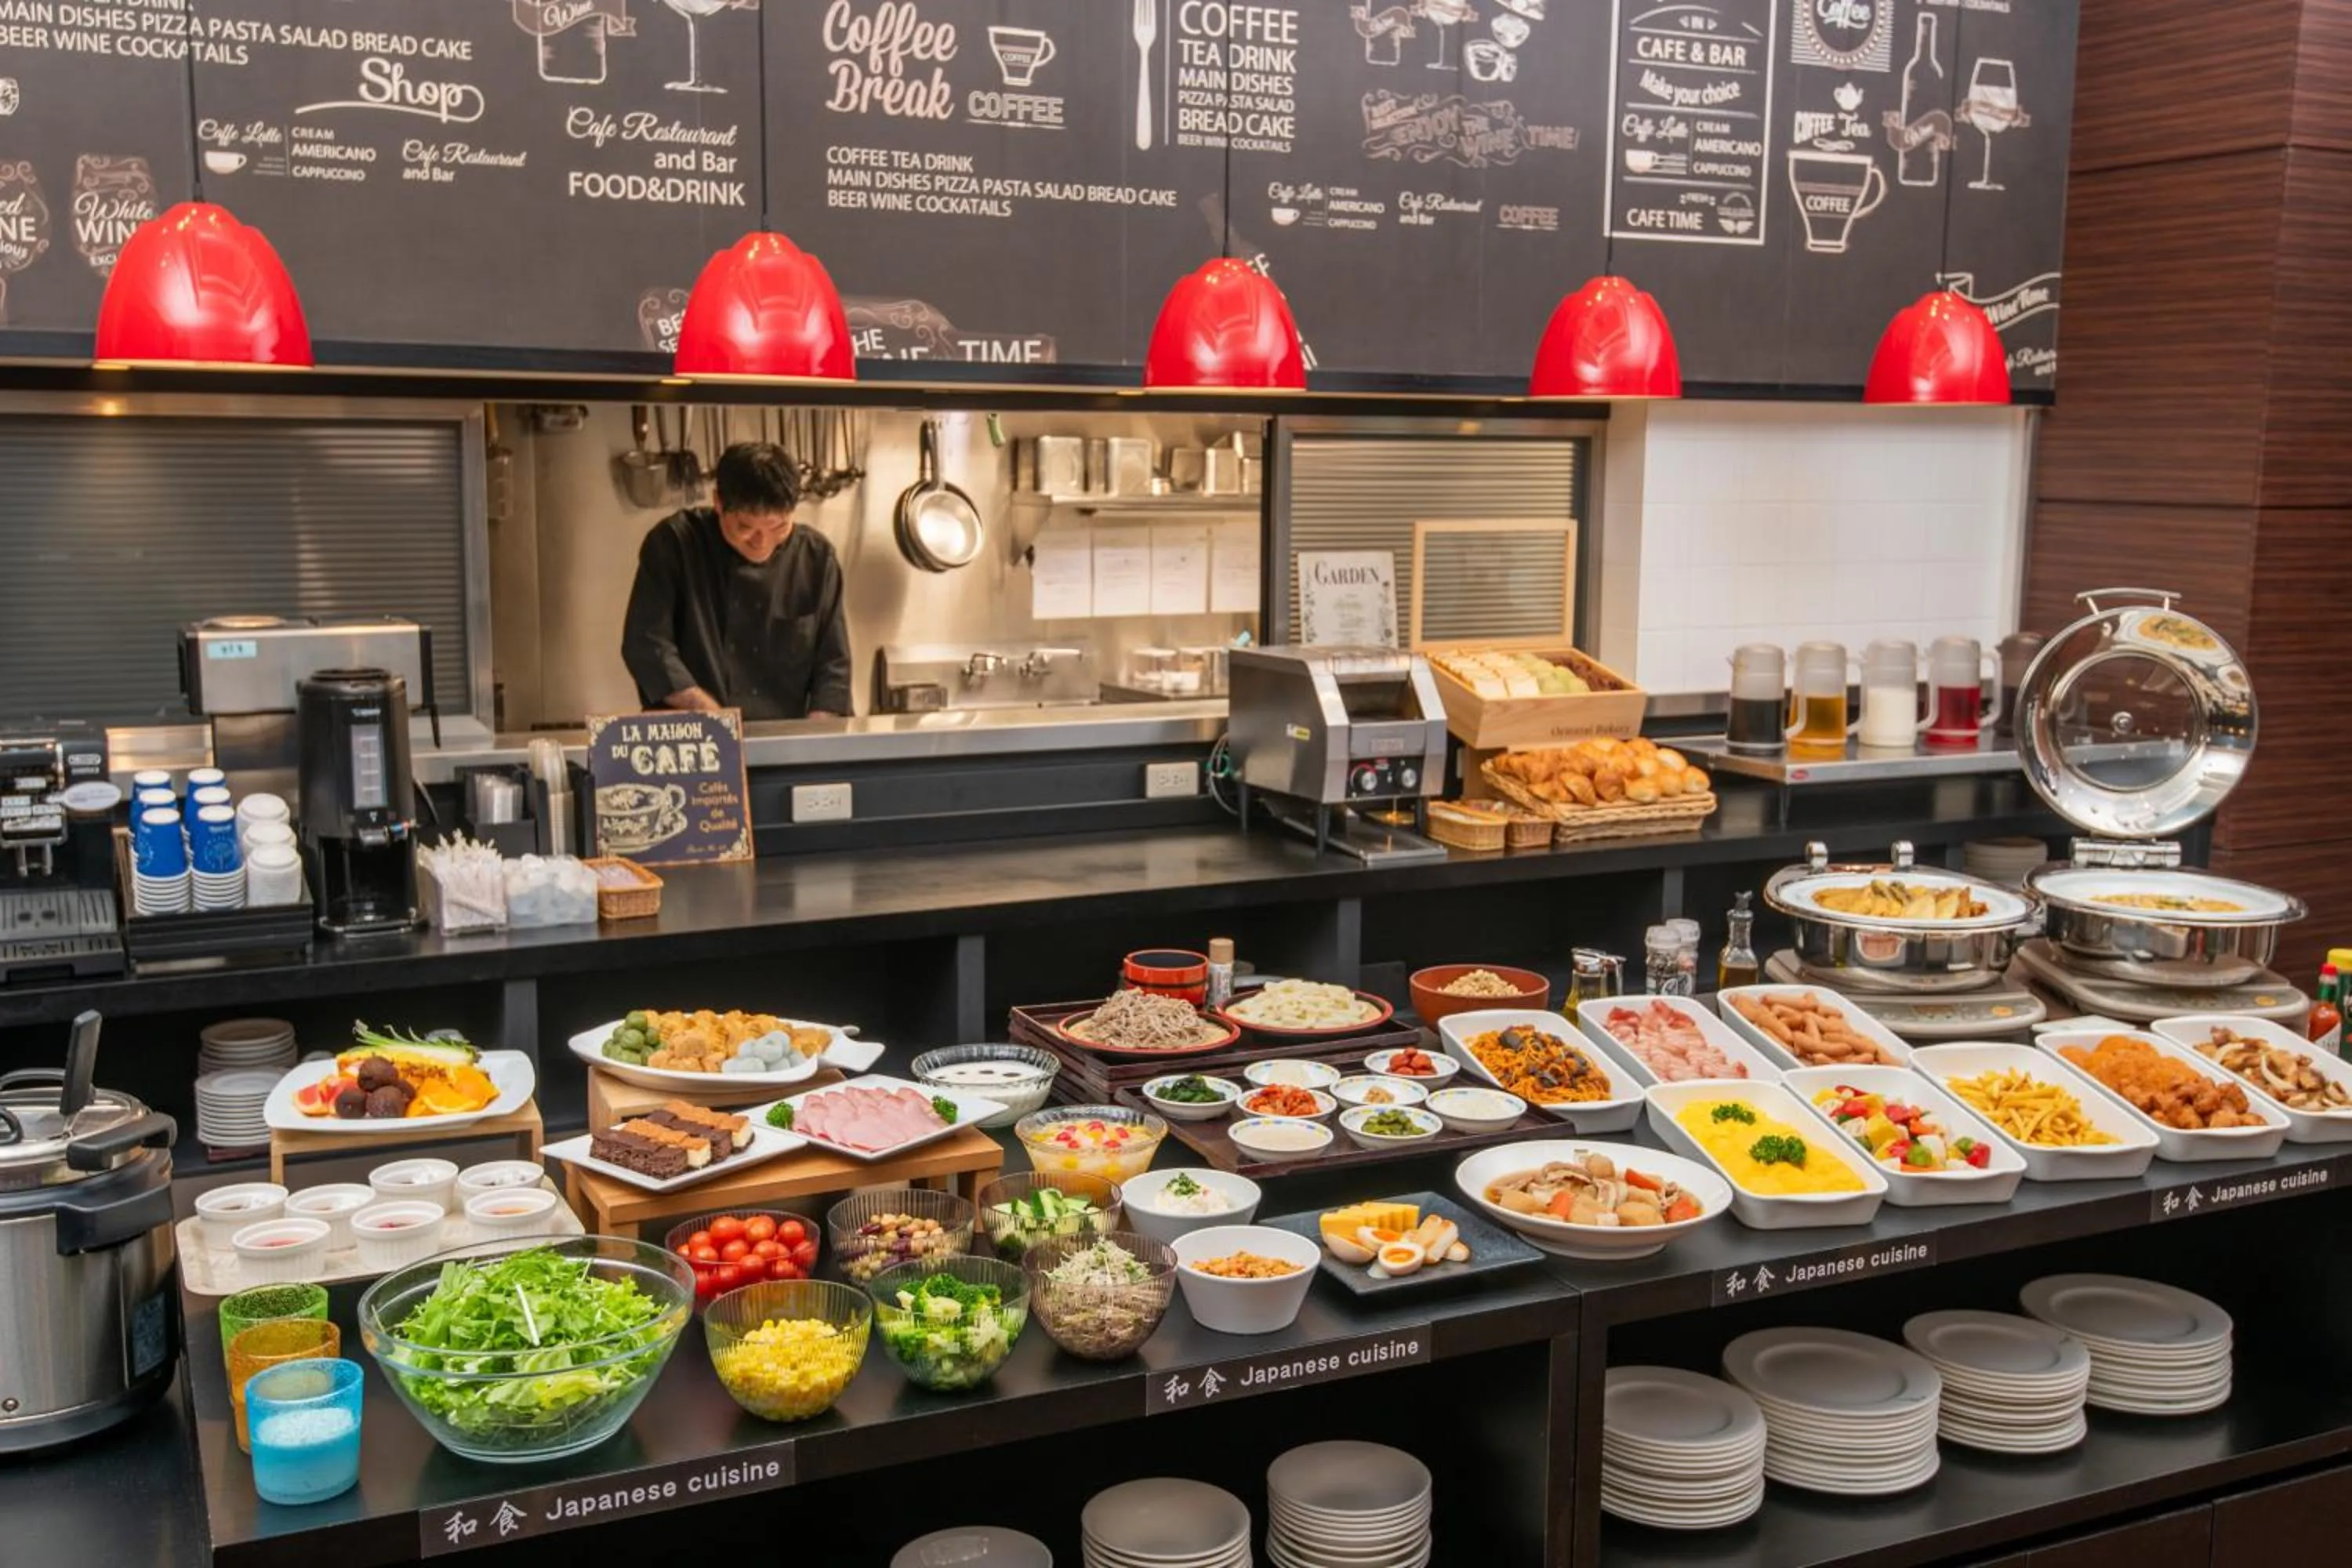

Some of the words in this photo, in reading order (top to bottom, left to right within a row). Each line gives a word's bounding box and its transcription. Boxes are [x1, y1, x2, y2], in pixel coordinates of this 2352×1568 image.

[0, 0, 53, 24] MAIN
[59, 4, 136, 31] DISHES
[141, 13, 204, 38] PIZZA
[208, 18, 275, 43] PASTA
[280, 24, 347, 49] SALAD
[352, 31, 417, 56] BREAD
[421, 38, 473, 60] CAKE
[1179, 1, 1299, 44] COFFEE
[0, 24, 49, 48] BEER
[53, 29, 112, 54] WINE
[117, 36, 249, 65] COCKATAILS
[823, 0, 958, 78] Coffee
[1636, 36, 1686, 61] CAFE
[1690, 42, 1705, 63] &
[1709, 43, 1747, 67] BAR
[1178, 39, 1222, 67] TEA
[1229, 43, 1297, 74] DRINK
[358, 56, 485, 123] Shop
[826, 58, 955, 120] Break
[1178, 67, 1227, 90] MAIN
[1231, 72, 1294, 96] DISHES
[1639, 68, 1674, 100] Make
[1672, 85, 1701, 107] your
[1701, 81, 1741, 104] choice
[967, 91, 1064, 123] COFFEE
[1178, 90, 1214, 106] PIZZA
[1255, 96, 1294, 113] SALAD
[291, 126, 335, 140] CREAM
[566, 106, 617, 147] Cafe
[621, 112, 738, 146] Restaurant
[1178, 108, 1243, 134] BREAD
[1245, 114, 1295, 138] CAKE
[1794, 111, 1835, 143] COFFEE
[1838, 112, 1871, 137] Tea
[291, 143, 377, 162] AMERICANO
[654, 149, 696, 170] and
[702, 151, 738, 173] Bar
[826, 146, 888, 167] COFFEE
[891, 150, 921, 169] TEA
[924, 153, 974, 173] DRINK
[1694, 138, 1762, 157] AMERICANO
[291, 166, 366, 181] CAPPUCCINO
[402, 166, 430, 180] and
[432, 167, 456, 182] Bar
[568, 171, 746, 206] FOOD&DRINK
[827, 168, 872, 187] MAIN
[875, 171, 931, 191] DISHES
[935, 175, 980, 194] PIZZA
[983, 178, 1032, 197] PASTA
[1034, 182, 1085, 201] SALAD
[1087, 185, 1136, 204] BREAD
[1138, 188, 1177, 206] CAKE
[74, 191, 154, 221] White
[828, 189, 868, 208] BEER
[870, 192, 913, 211] WINE
[916, 195, 1011, 217] COCKATAILS
[1806, 195, 1851, 212] COFFEE
[75, 218, 138, 244] WIN
[1627, 208, 1665, 228] CAFE
[1667, 210, 1704, 230] TIME
[851, 328, 887, 357] HE
[1315, 561, 1380, 585] GARDEN
[622, 724, 642, 742] LA
[647, 722, 702, 741] MAISON
[612, 745, 628, 759] DU
[630, 735, 720, 775] CAFÉ
[2162, 1185, 2204, 1214] 和食
[2211, 1178, 2277, 1203] Japanese
[2281, 1169, 2328, 1189] cuisine
[1726, 1265, 1776, 1298] 和食
[1785, 1255, 1865, 1283] Japanese
[1871, 1244, 1928, 1267] cuisine
[1163, 1367, 1226, 1404] 和食
[1240, 1354, 1341, 1386] Japanese
[1348, 1338, 1419, 1366] cuisine
[444, 1501, 528, 1544] 和食
[546, 1481, 677, 1521] Japanese
[687, 1460, 781, 1492] cuisine
